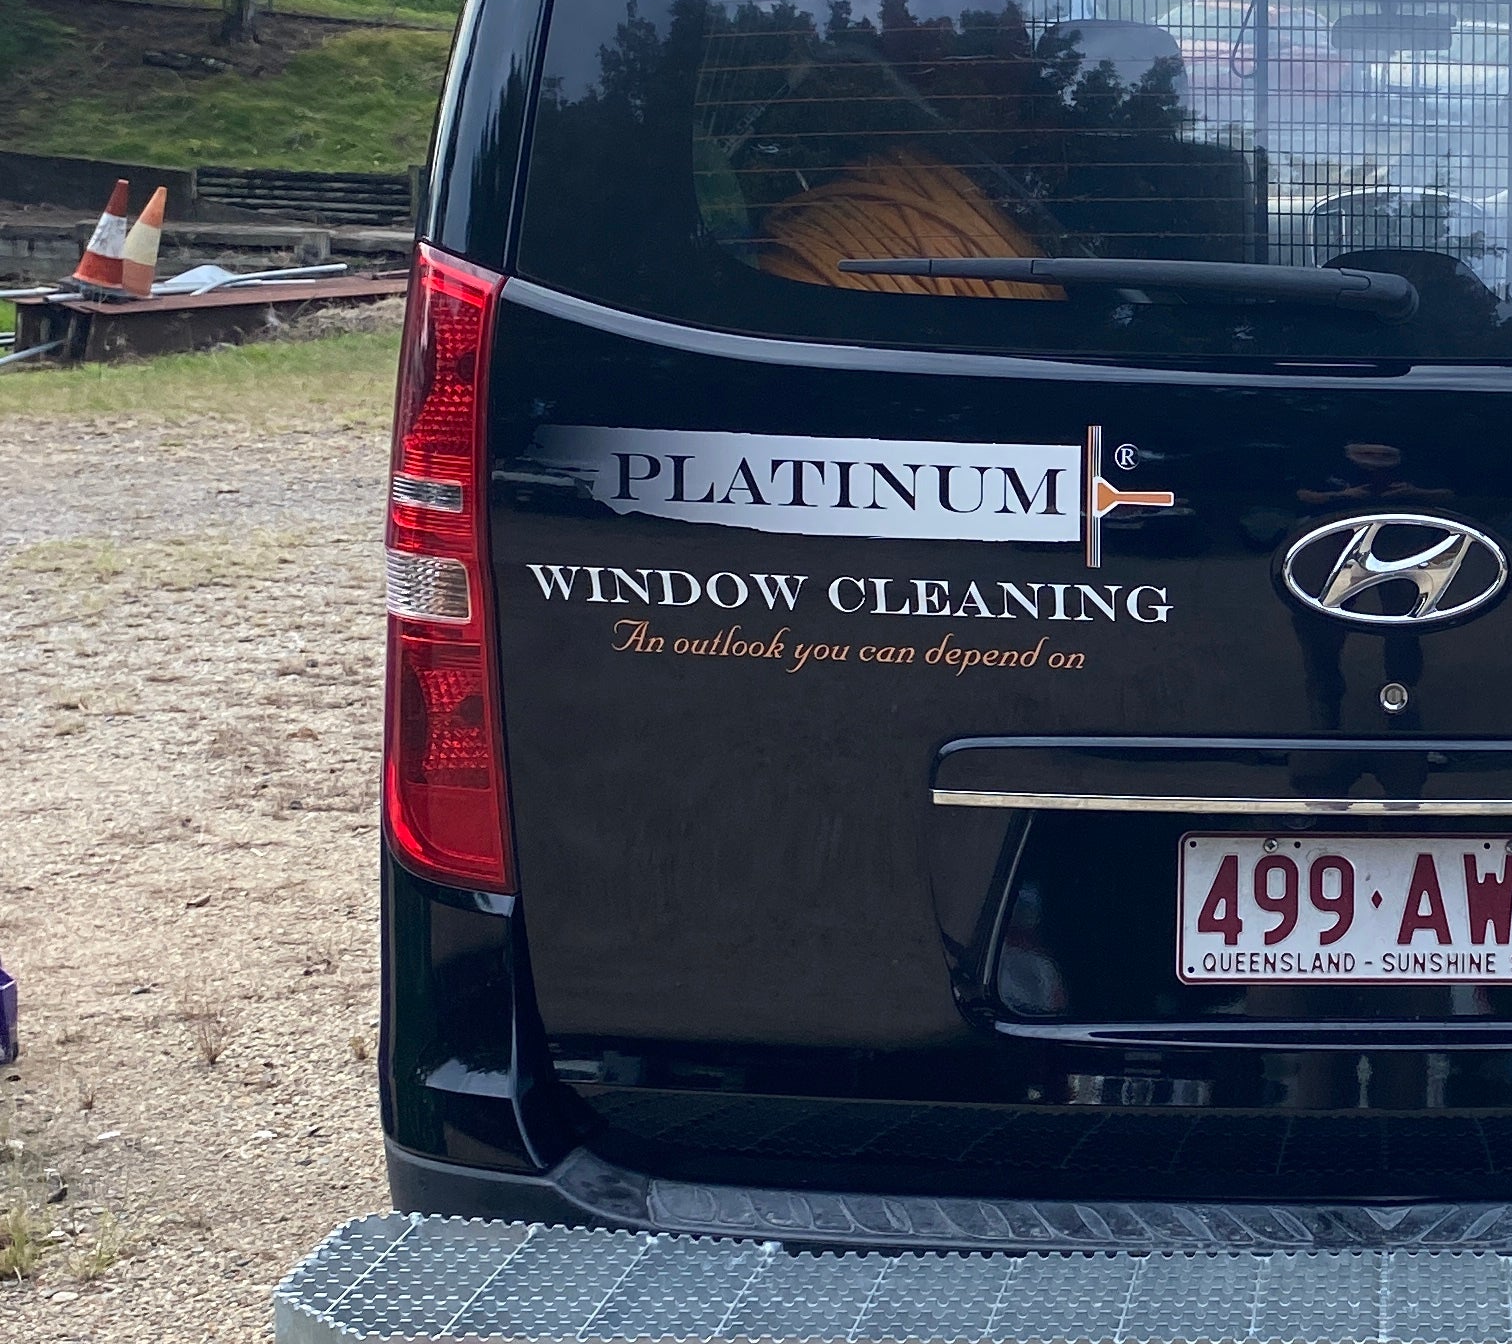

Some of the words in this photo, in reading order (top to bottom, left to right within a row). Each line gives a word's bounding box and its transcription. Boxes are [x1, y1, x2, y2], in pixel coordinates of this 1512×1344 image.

[610, 452, 1067, 516] PLATINUM
[526, 564, 809, 612] WINDOW
[828, 577, 1174, 623] CLEANING
[611, 619, 664, 653] An
[673, 625, 791, 659] outlook
[785, 642, 850, 673] you
[858, 644, 916, 664] can
[925, 632, 1051, 677] depend
[1048, 651, 1086, 670] on
[1202, 952, 1356, 975] QUEENSLAND
[1382, 952, 1497, 975] SUNSHINE
